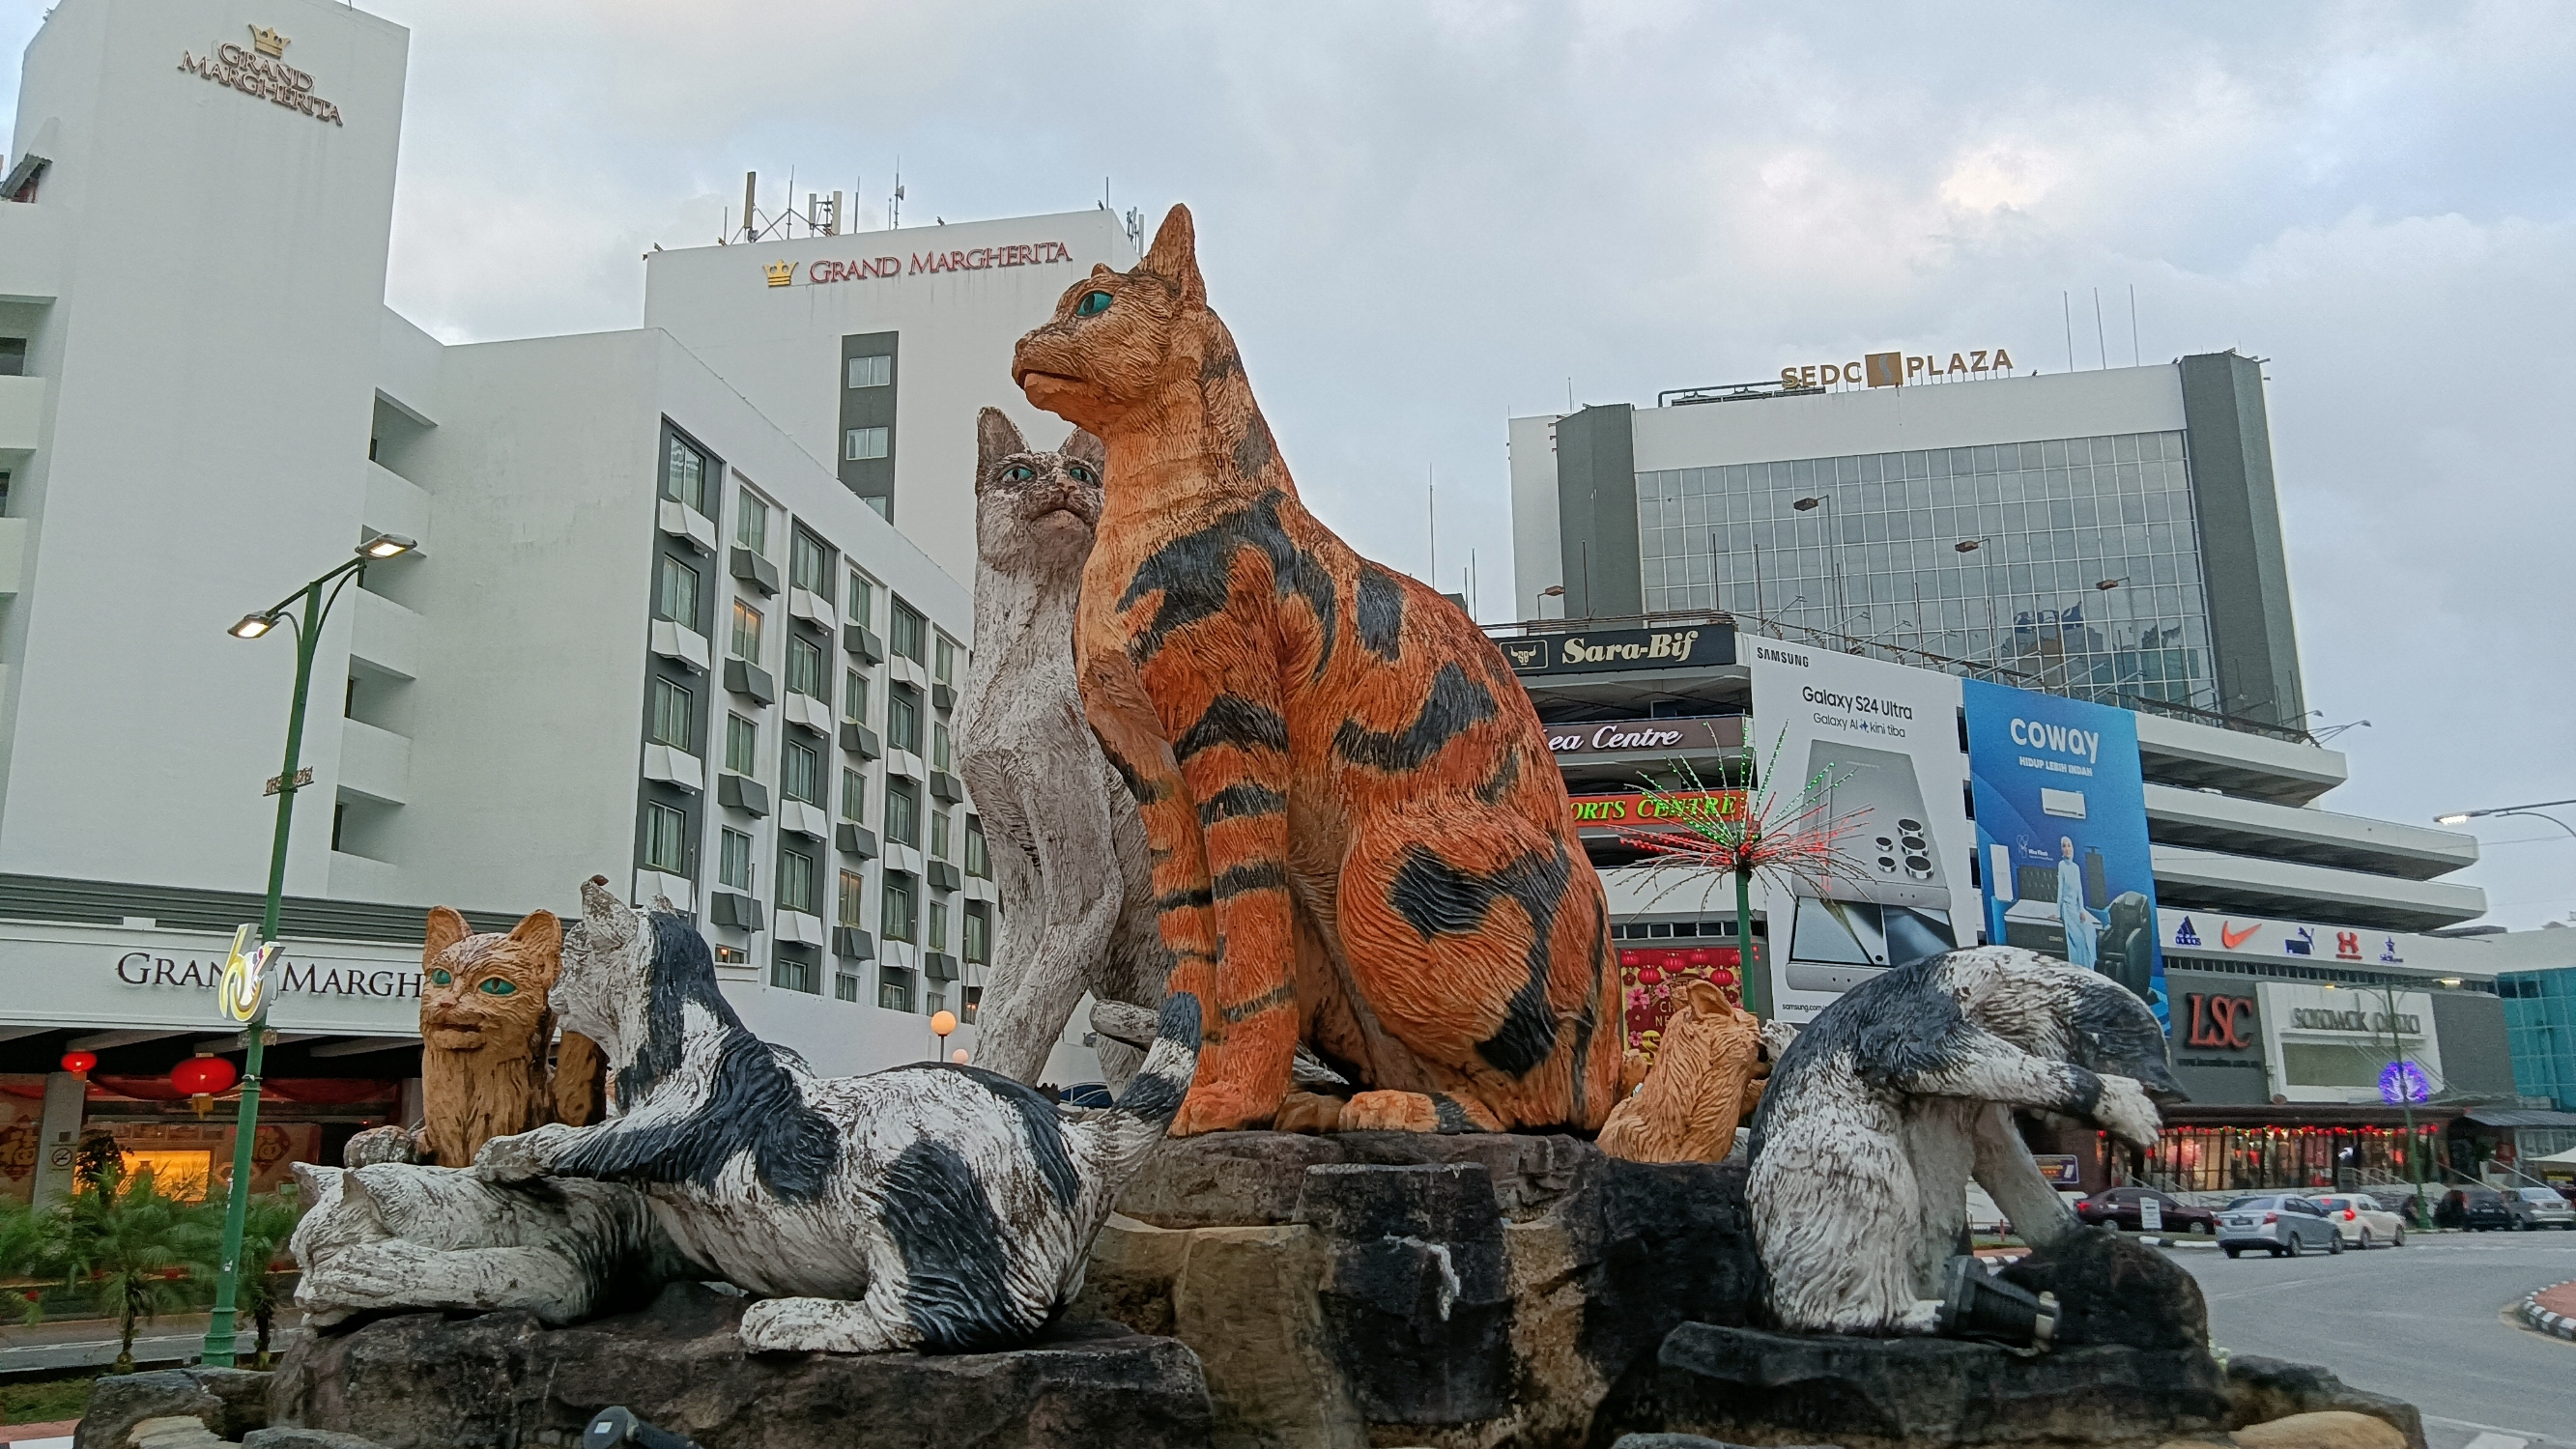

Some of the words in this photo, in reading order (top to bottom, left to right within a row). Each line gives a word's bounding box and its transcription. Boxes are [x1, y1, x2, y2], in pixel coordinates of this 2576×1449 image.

[218, 43, 314, 93] GRAND
[177, 50, 344, 127] MARGHERITA
[809, 256, 902, 284] GRAND
[908, 242, 1073, 275] MARGHERITA
[1781, 362, 1863, 389] SEDC
[1906, 349, 2014, 378] PLAZA
[1562, 631, 1699, 664] Sara-Bif
[1757, 646, 1810, 668] SAMSUNG
[1802, 686, 1853, 713] Galaxy
[1855, 695, 1878, 715] S24
[1881, 699, 1913, 720] Ultra
[1548, 735, 1585, 751] ea
[1591, 724, 1683, 749] Centre
[1813, 712, 1847, 731] Galaxy
[1870, 722, 1885, 734] kini
[1887, 724, 1905, 737] tiba
[2018, 755, 2045, 769] HIDUP
[2046, 759, 2067, 773] LEBIH
[1570, 800, 1626, 820] ORTS
[1637, 796, 1737, 817] CENTRE
[117, 952, 223, 988] GRAN
[279, 961, 424, 999] MARGH
[2188, 993, 2253, 1049] LSC
